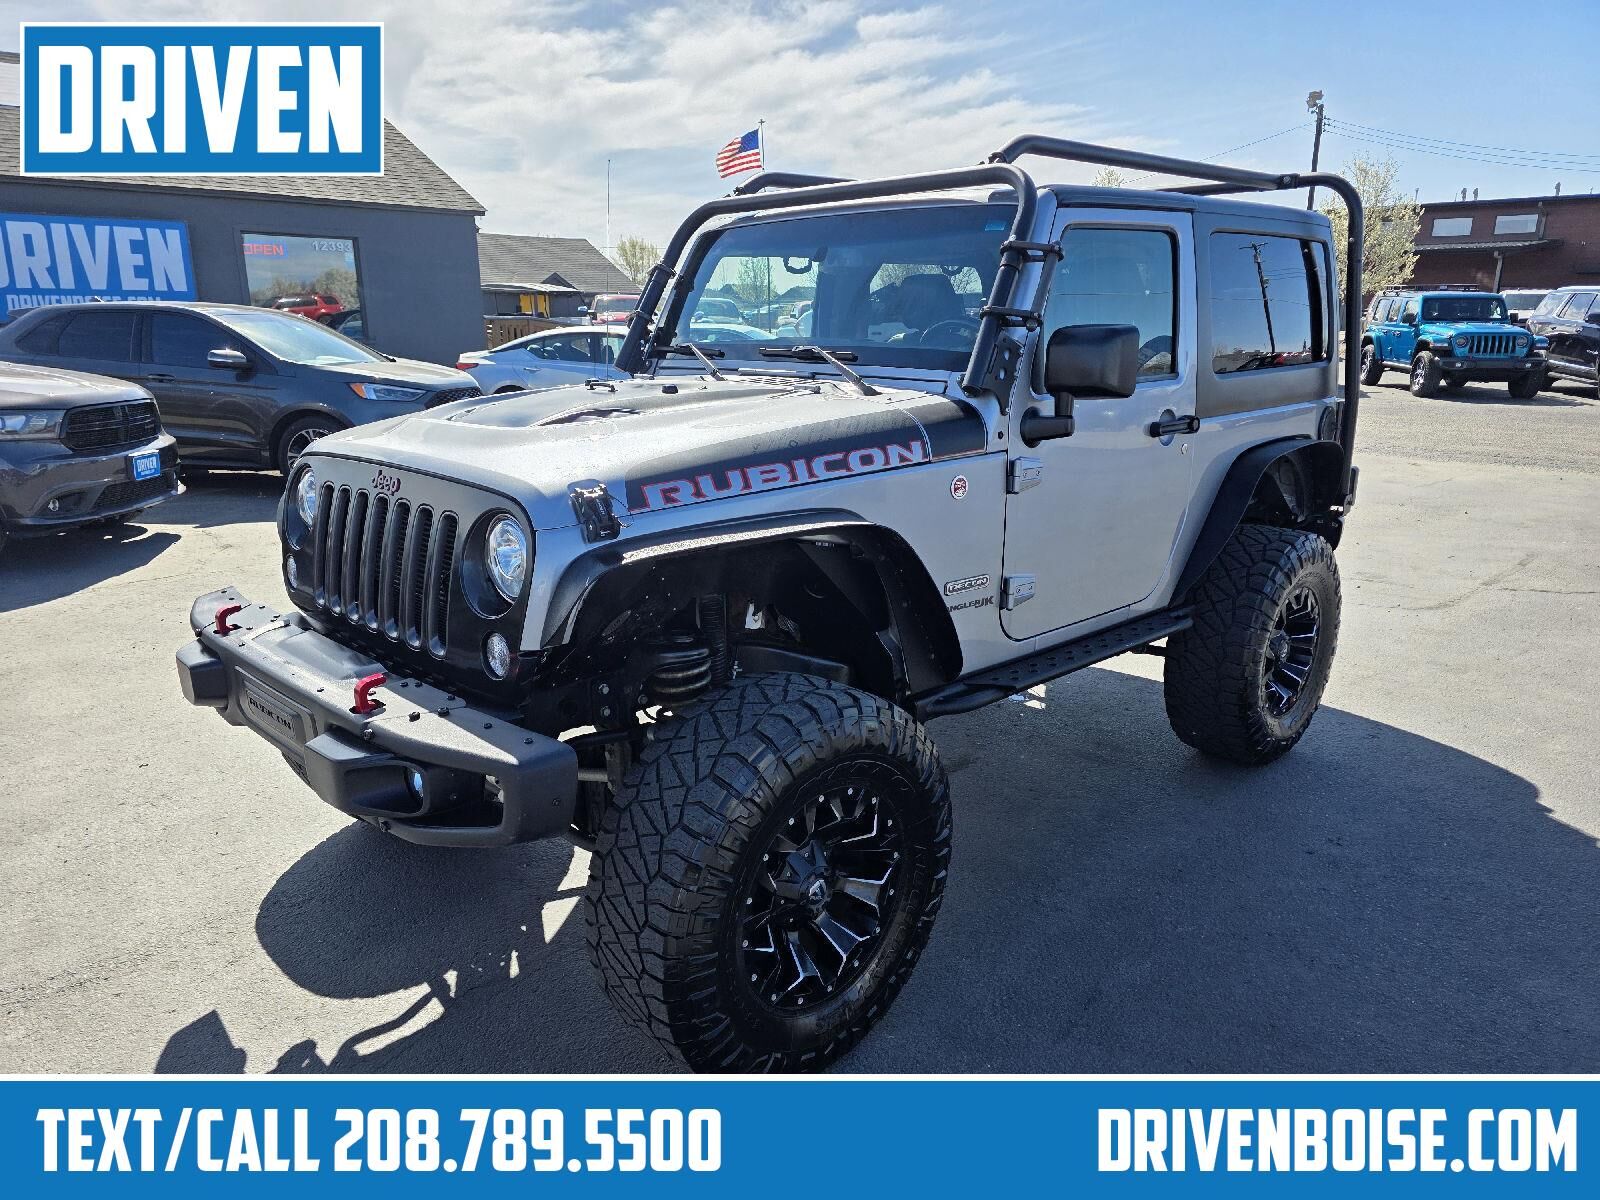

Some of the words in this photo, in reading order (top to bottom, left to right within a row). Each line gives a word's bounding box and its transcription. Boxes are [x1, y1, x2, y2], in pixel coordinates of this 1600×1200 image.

[243, 243, 284, 256] OPEN
[312, 240, 352, 252] 12393
[137, 456, 157, 472] DRIVEN
[372, 469, 401, 496] Jeep
[629, 440, 928, 513] RUBICON
[946, 599, 980, 612] NGLER
